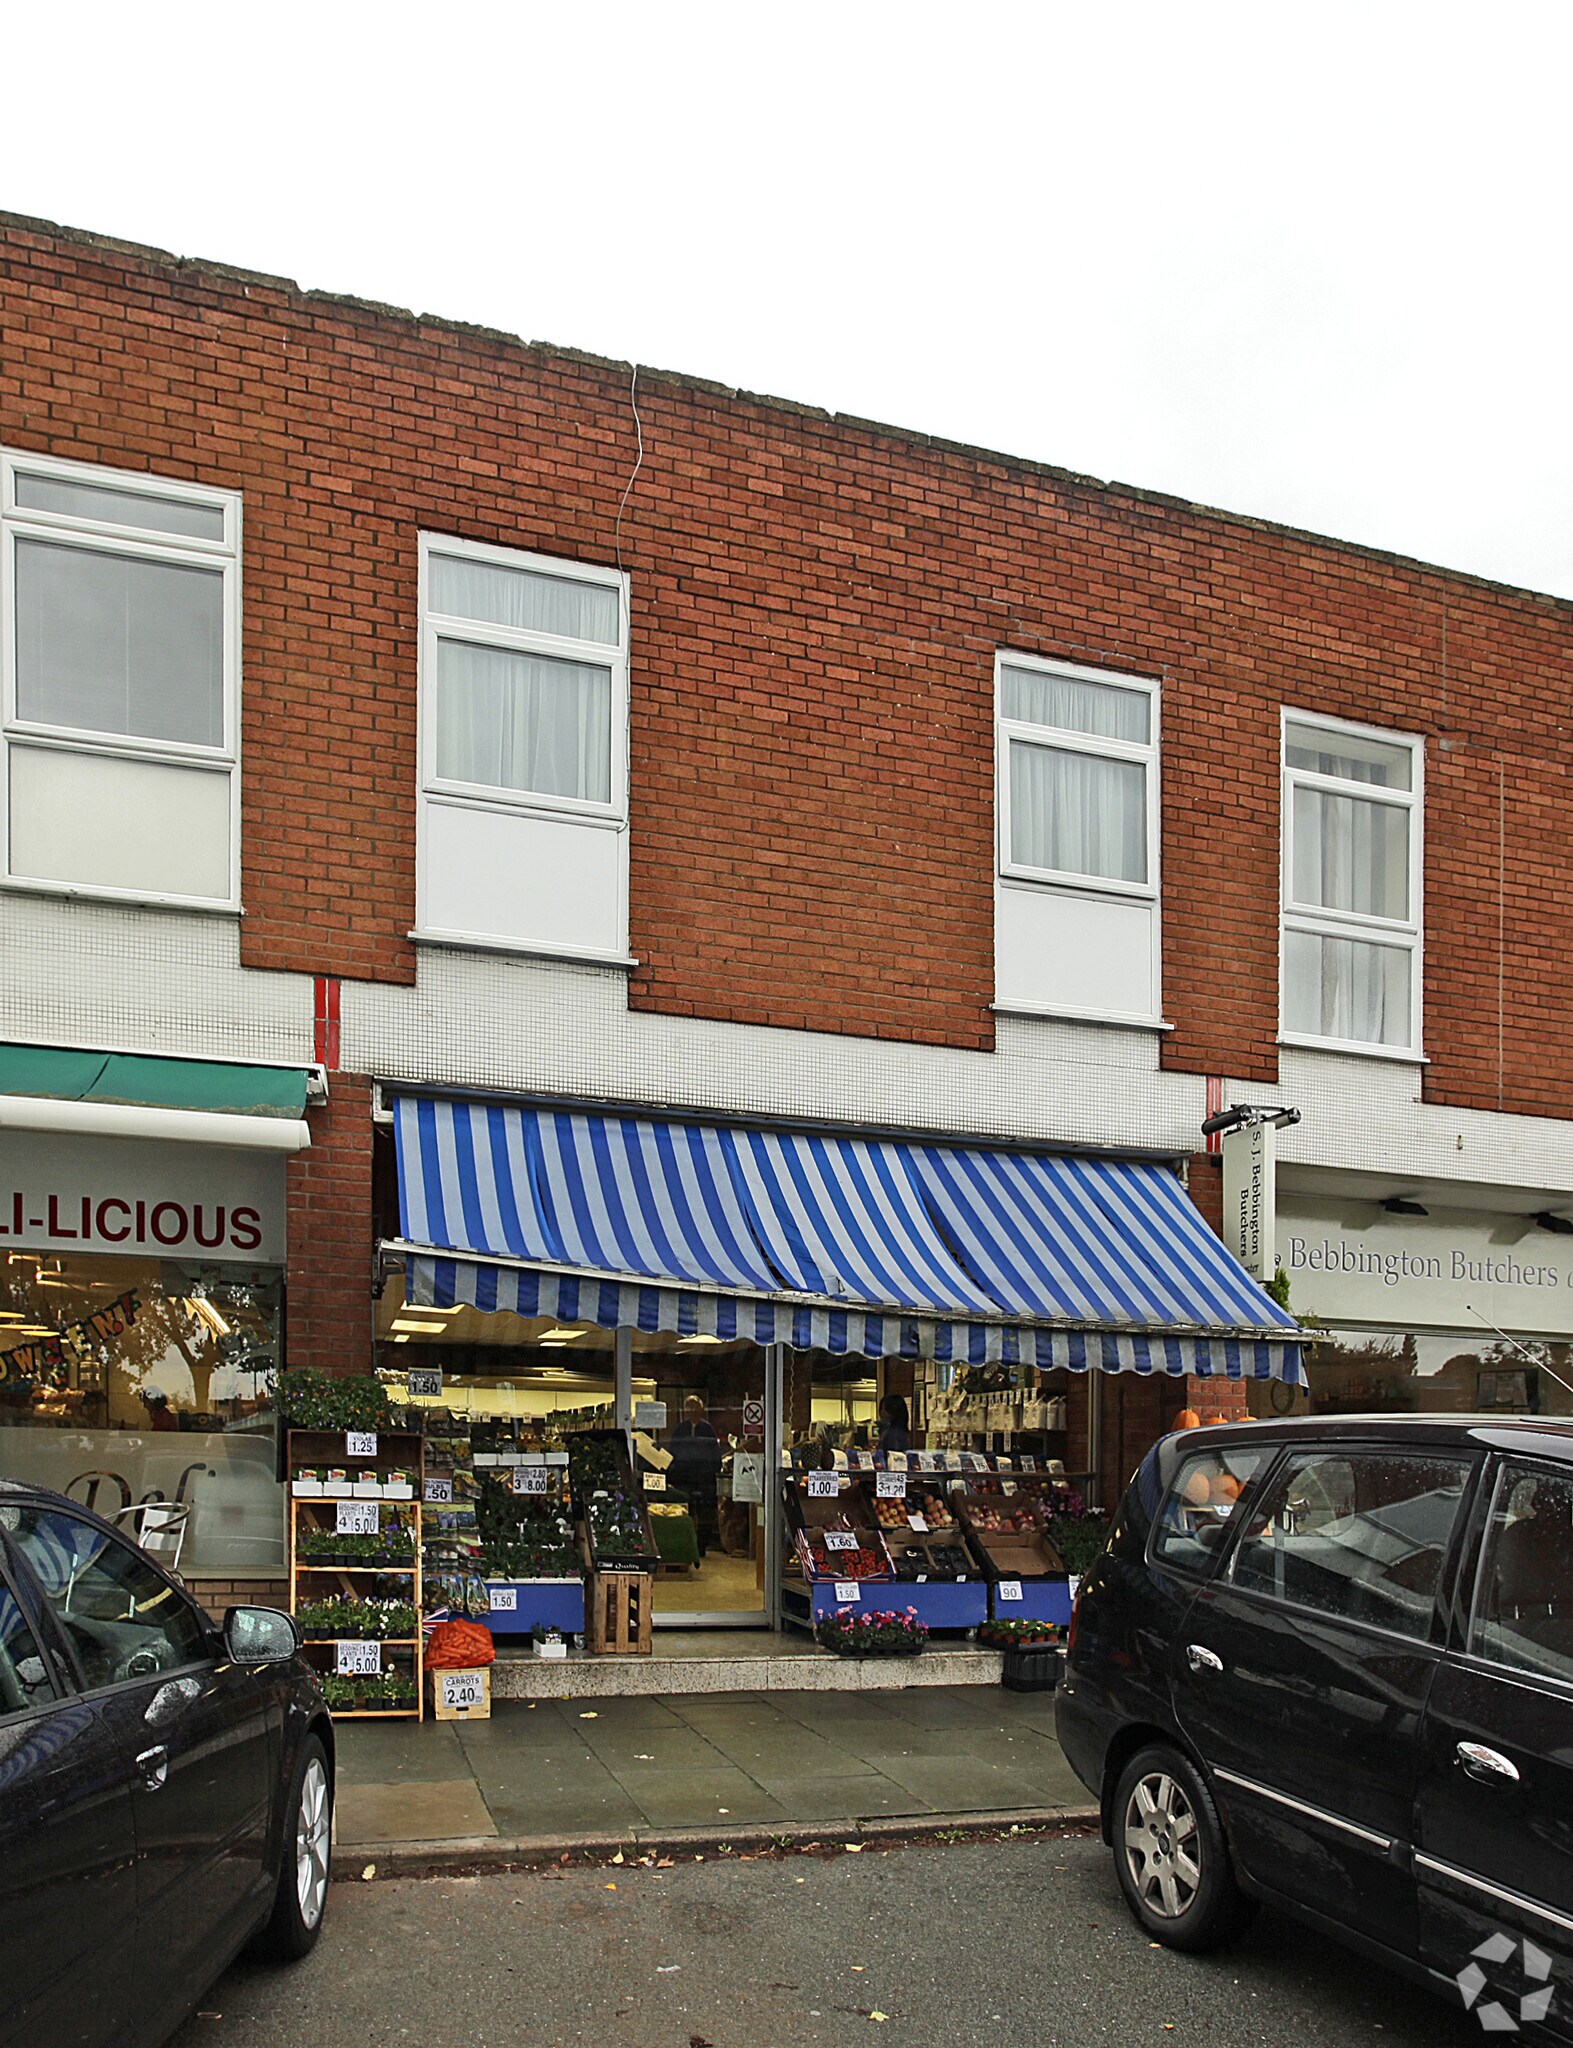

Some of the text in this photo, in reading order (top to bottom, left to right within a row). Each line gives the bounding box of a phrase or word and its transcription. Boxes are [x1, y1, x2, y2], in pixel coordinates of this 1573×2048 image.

[1250, 1130, 1262, 1256] S. J. Bebbington
[1240, 1188, 1249, 1257] Butchers
[1289, 1237, 1442, 1286] Bebbington
[1450, 1250, 1559, 1288] Butchers
[412, 1381, 438, 1394] 1.50
[352, 1441, 373, 1453] 1.25
[515, 1479, 521, 1490] 3
[527, 1480, 546, 1491] 8.00
[812, 1481, 831, 1495] 1.00
[427, 1490, 448, 1500] .50
[361, 1505, 377, 1516] 1.50
[339, 1516, 376, 1532] 4 5.00
[830, 1538, 852, 1548] 1.60
[839, 1590, 854, 1599] 1.50
[1003, 1588, 1017, 1598] 90
[493, 1597, 512, 1607] 1.50
[362, 1645, 379, 1656] 1.50
[340, 1657, 377, 1672] 4 5.00
[446, 1677, 480, 1687] CARROTS
[447, 1687, 475, 1703] 2.40
